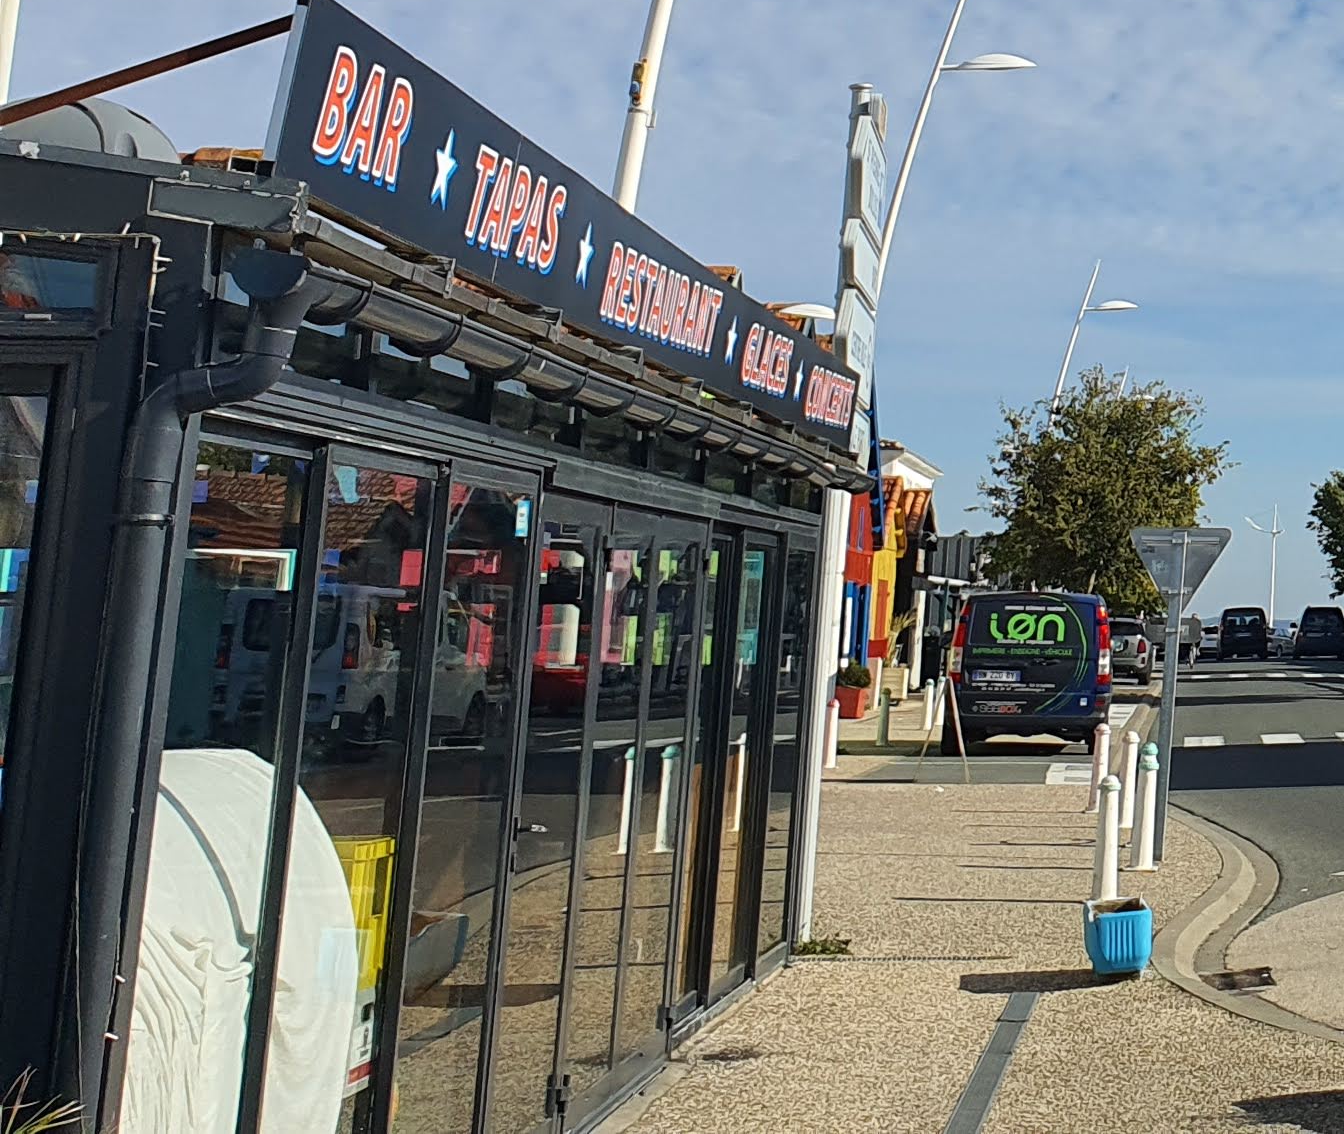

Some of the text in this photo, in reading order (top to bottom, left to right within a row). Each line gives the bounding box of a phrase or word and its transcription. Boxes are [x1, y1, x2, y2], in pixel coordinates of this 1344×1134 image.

[312, 45, 856, 431] BAR TAPAS RESTAURANT GLACES CONCERTS
